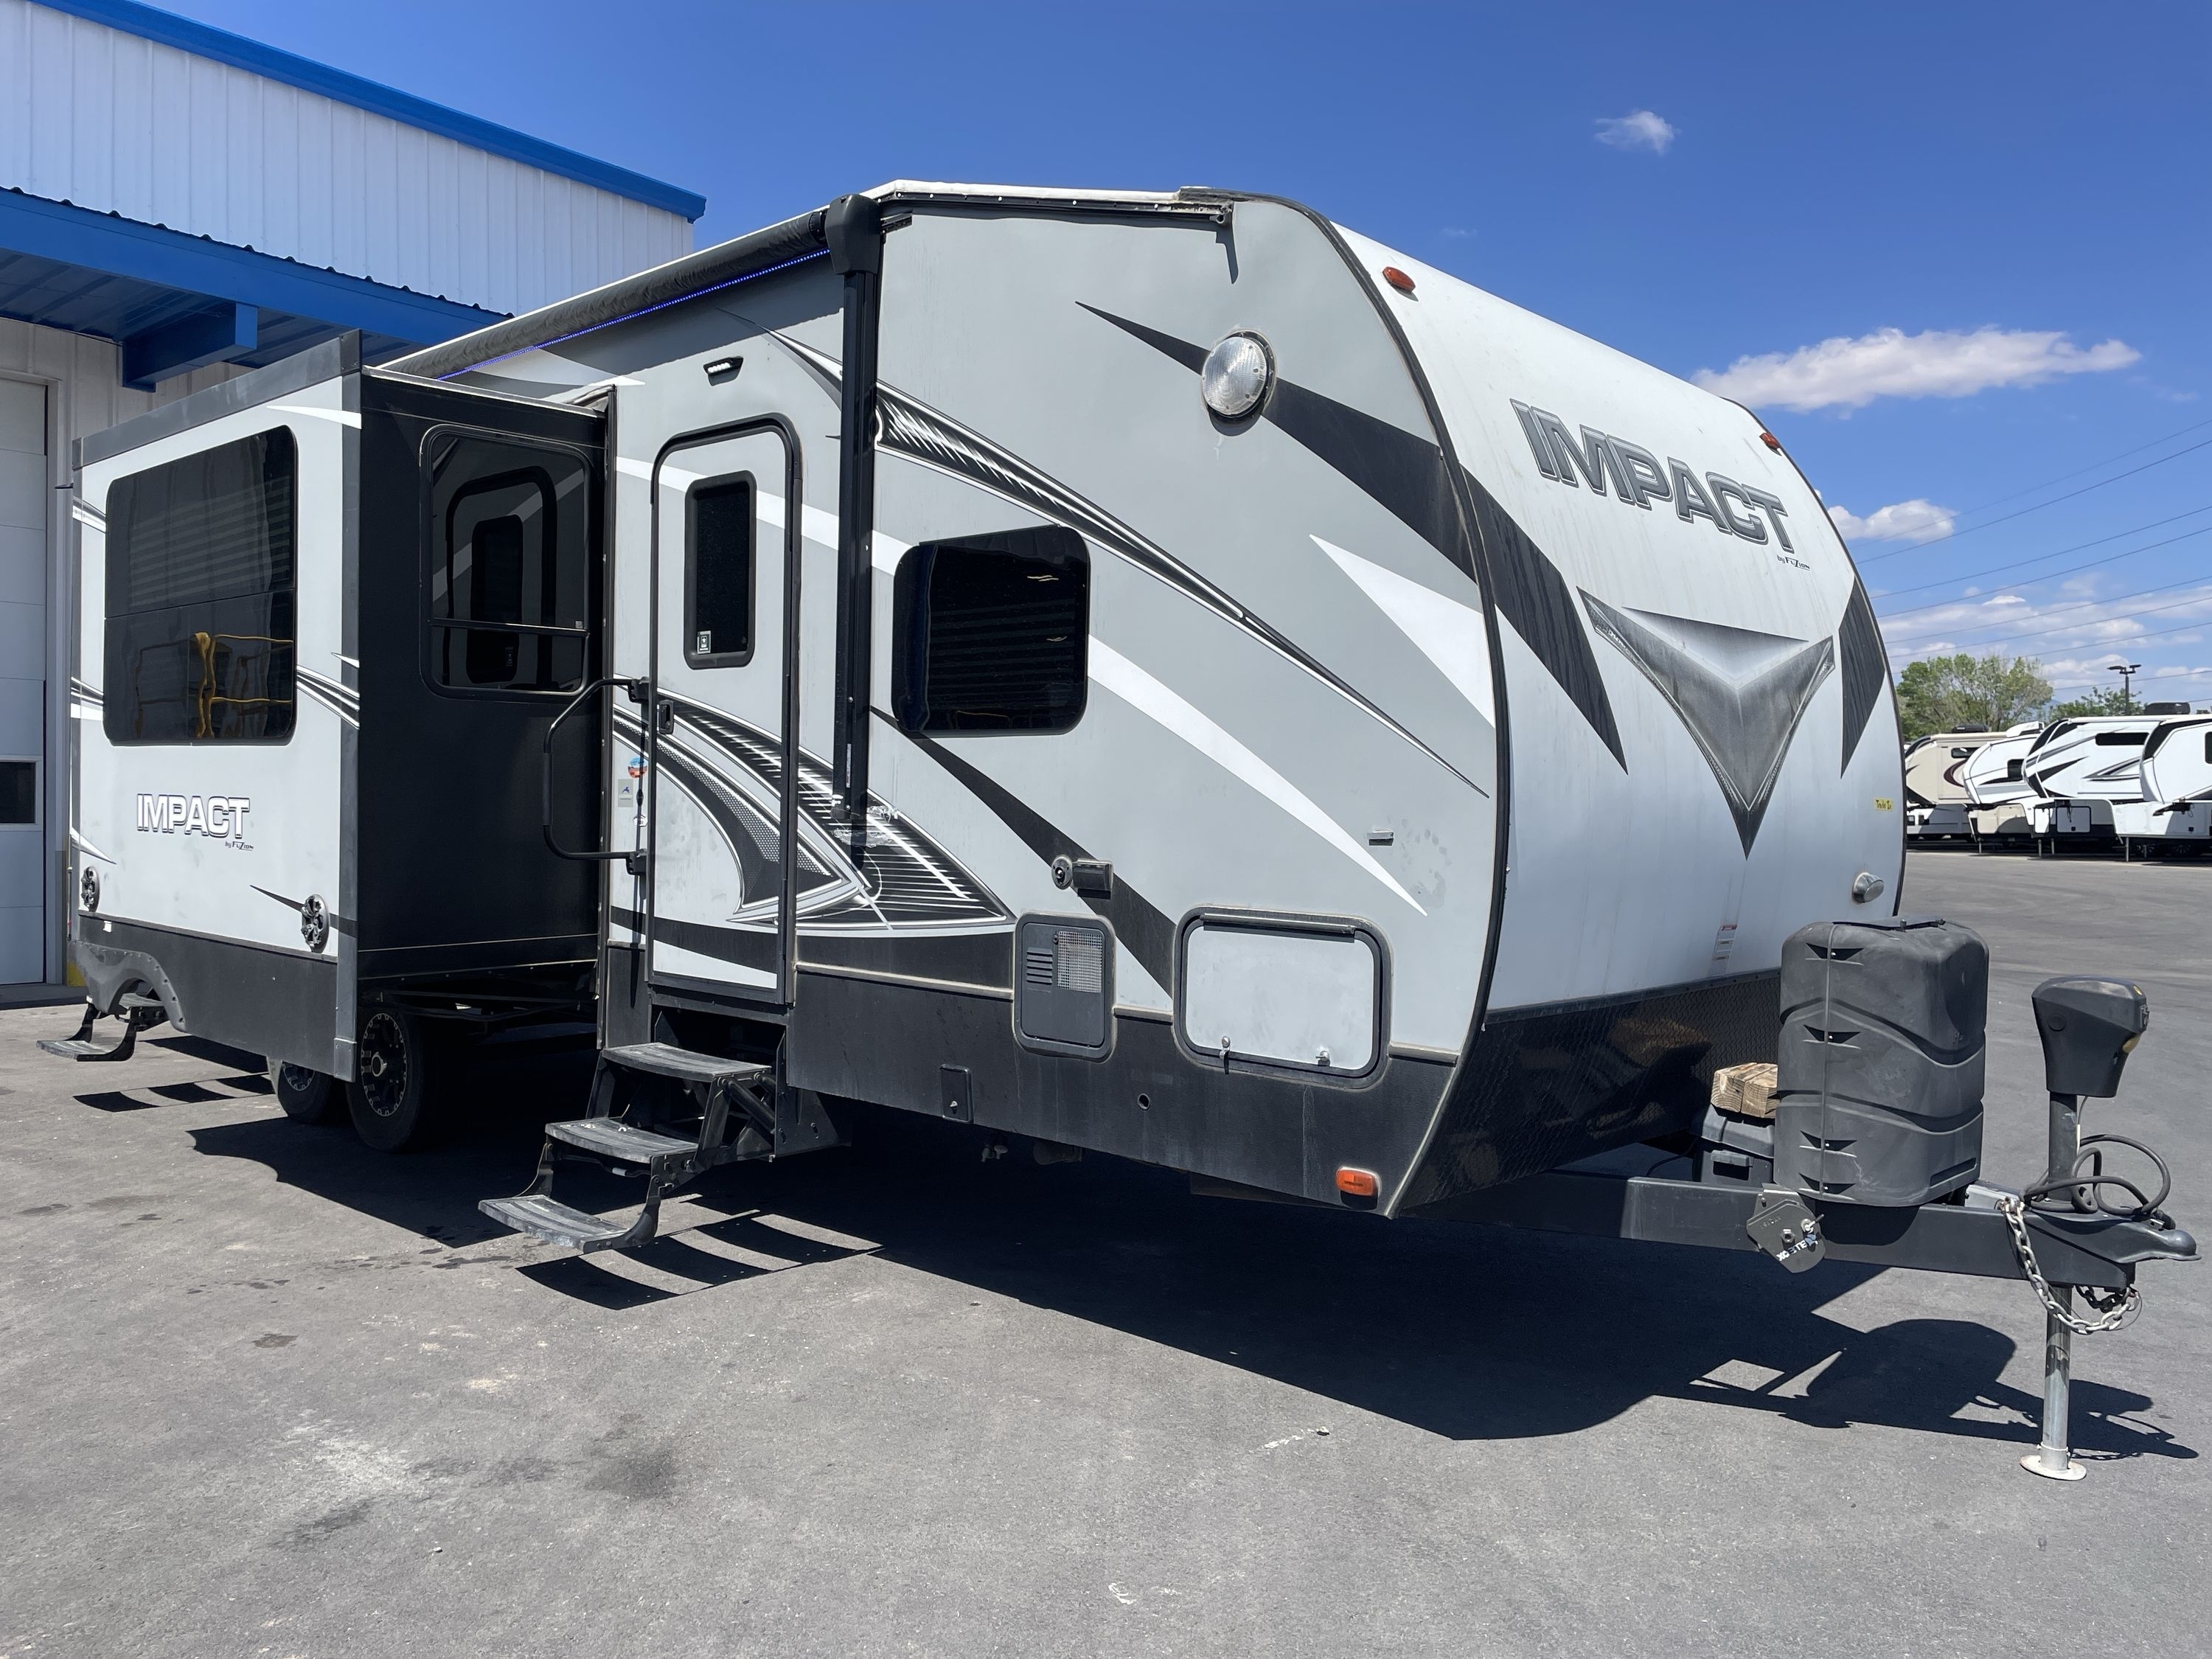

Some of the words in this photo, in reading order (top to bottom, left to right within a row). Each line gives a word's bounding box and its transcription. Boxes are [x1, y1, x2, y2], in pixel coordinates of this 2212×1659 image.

[1509, 398, 1795, 553] IMPACT
[137, 793, 250, 839] IMPACT
[225, 841, 232, 849] by
